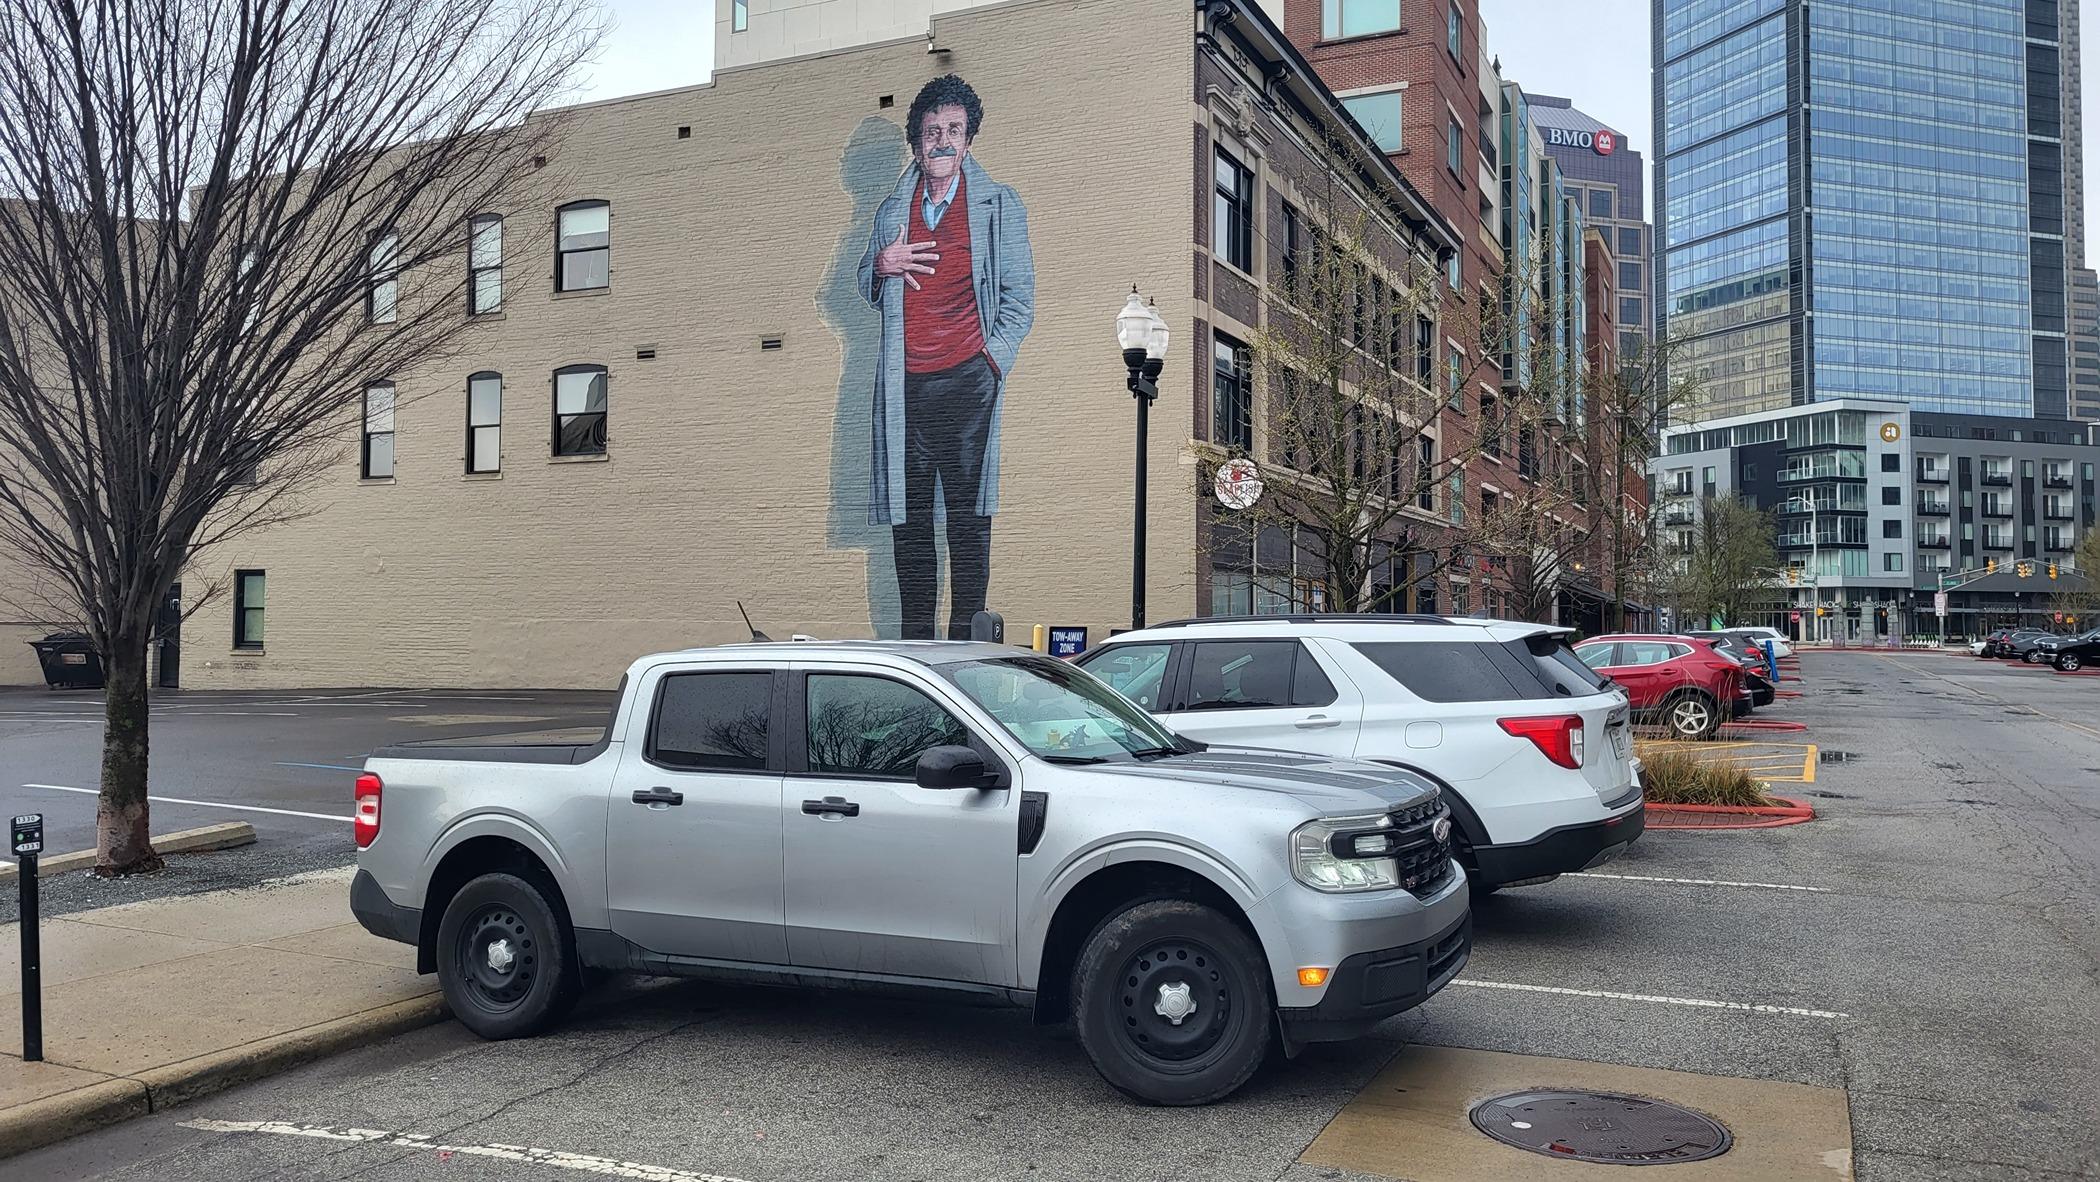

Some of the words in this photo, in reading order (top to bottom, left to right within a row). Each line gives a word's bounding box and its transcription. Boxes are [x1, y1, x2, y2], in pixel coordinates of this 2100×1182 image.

[1549, 128, 1593, 148] BMO
[1793, 601, 1814, 609] SHAKE
[1052, 631, 1084, 642] TOW-AWAY
[1060, 643, 1075, 653] ZONE
[17, 815, 35, 823] 1330
